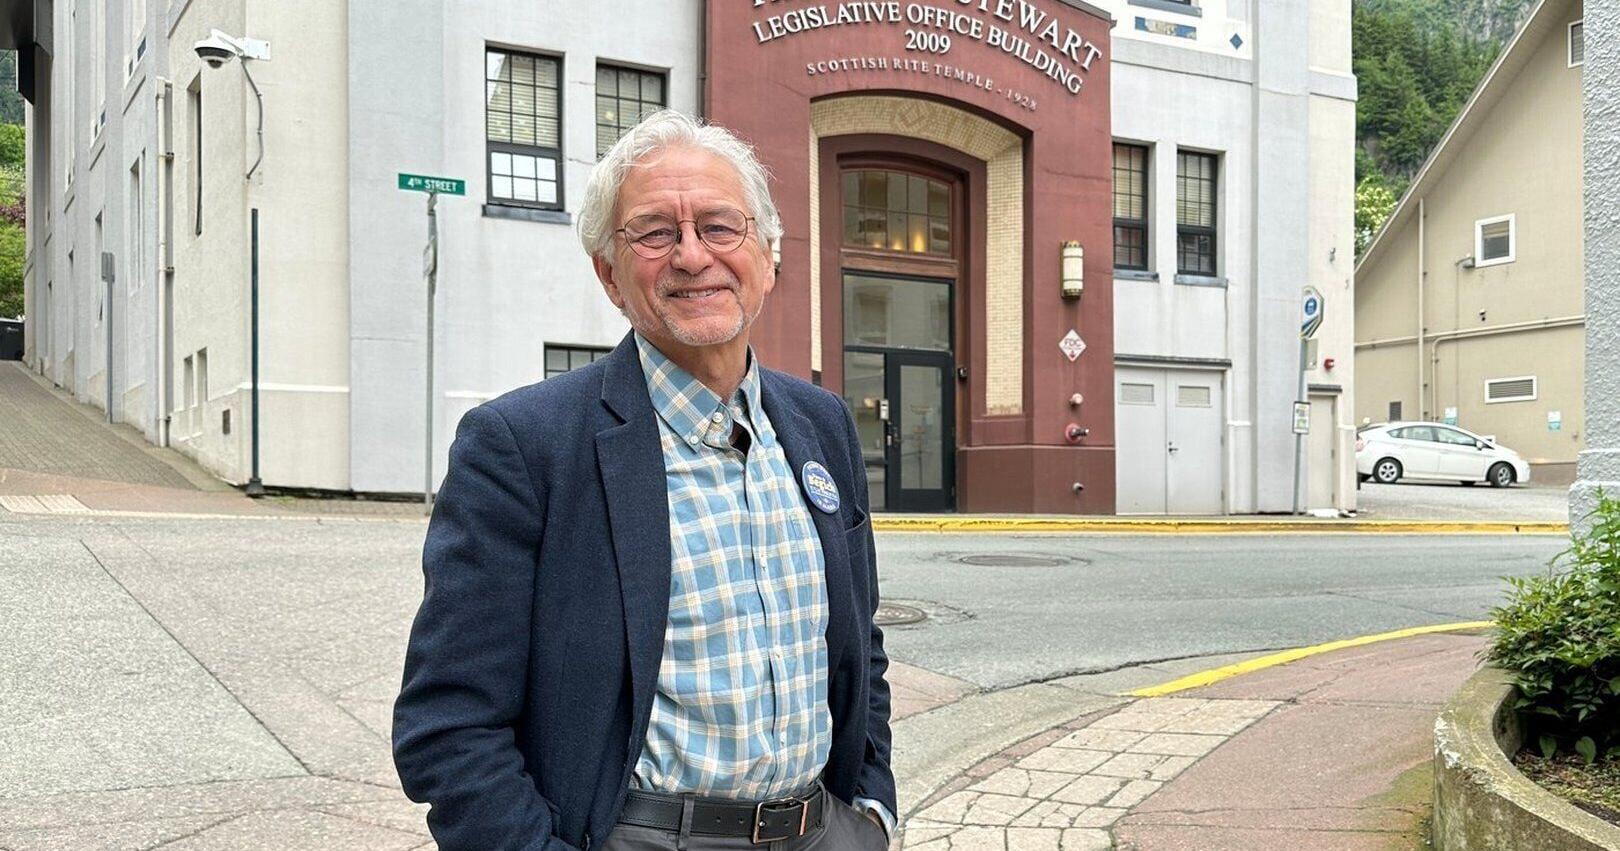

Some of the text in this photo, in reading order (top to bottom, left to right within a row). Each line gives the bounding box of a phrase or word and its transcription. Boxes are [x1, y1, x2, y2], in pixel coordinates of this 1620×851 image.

[752, 1, 1083, 94] LEGISLATIVE OFFICE BUILDING
[904, 29, 951, 54] 2009
[956, 0, 1102, 71] EWART
[806, 57, 888, 75] SCOTTISH
[893, 58, 930, 73] RITE
[934, 63, 994, 91] TEMPLE
[424, 179, 458, 192] STREET
